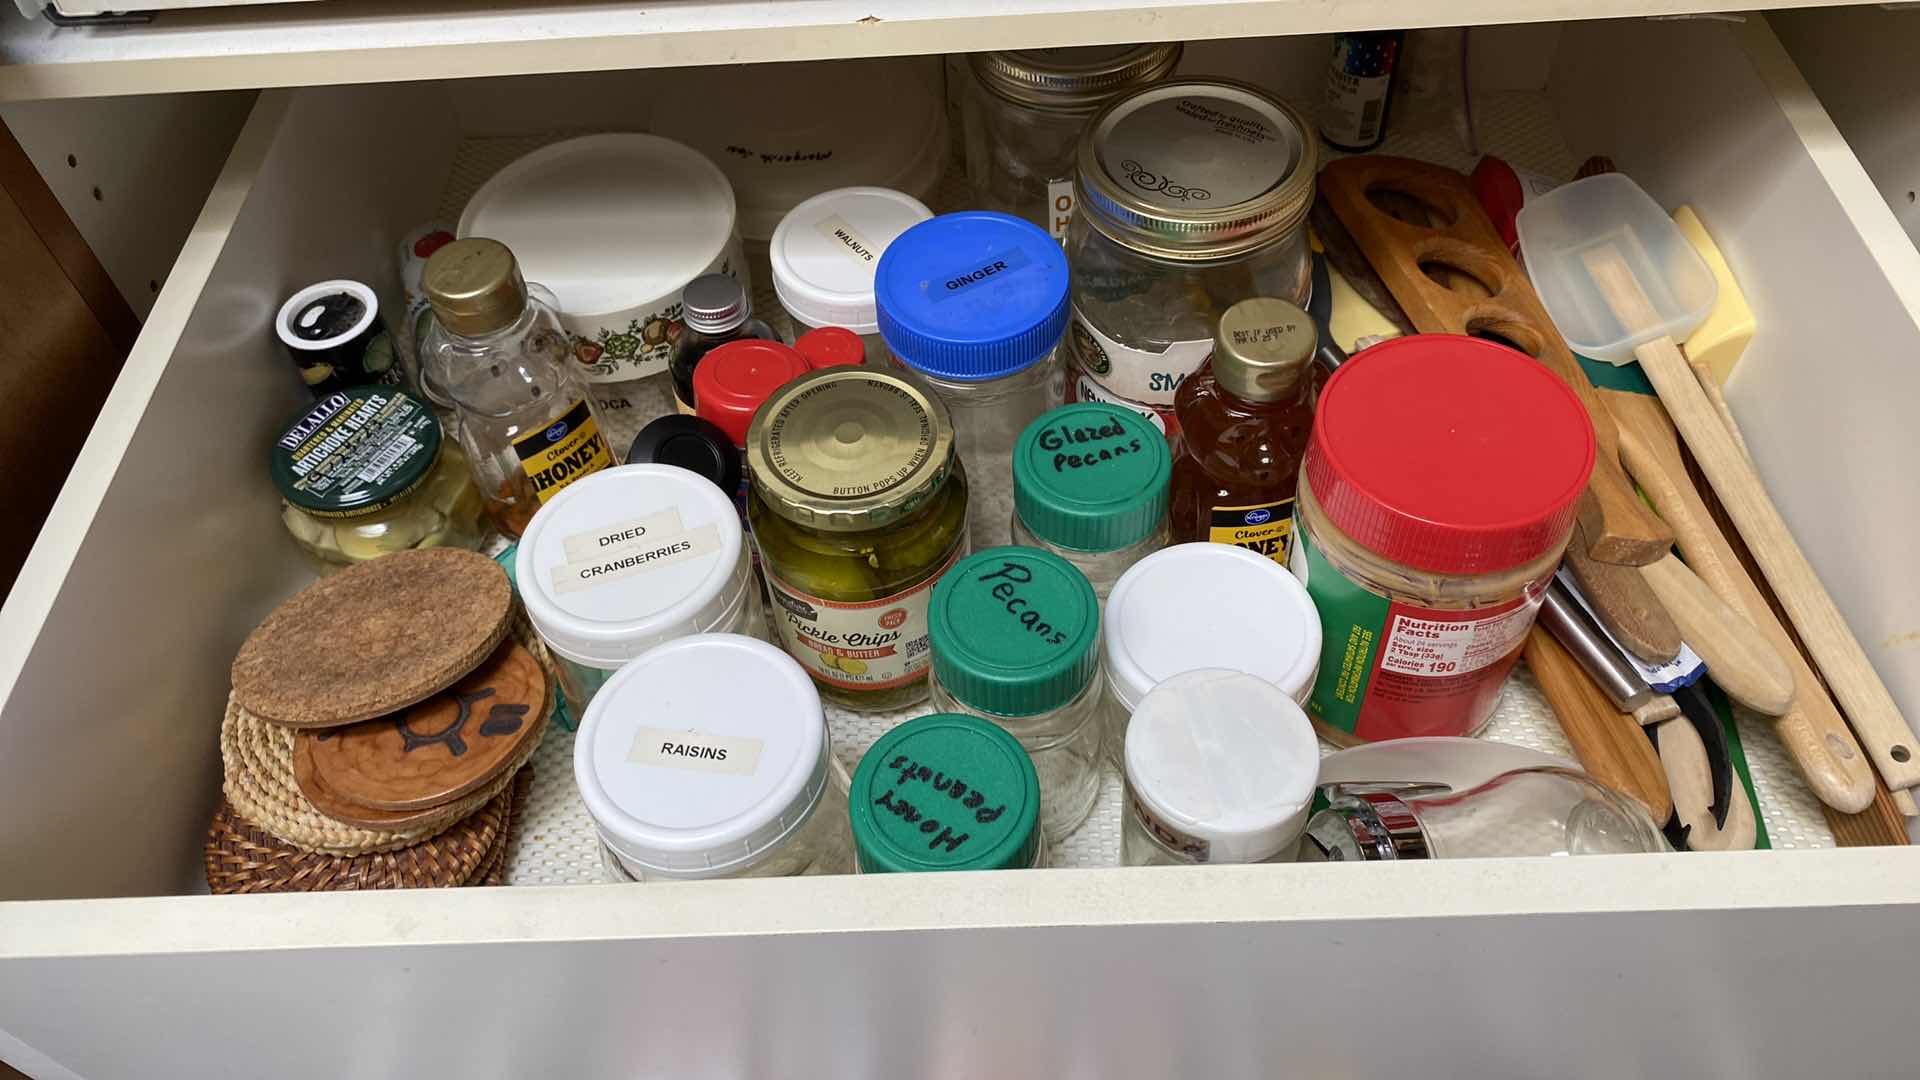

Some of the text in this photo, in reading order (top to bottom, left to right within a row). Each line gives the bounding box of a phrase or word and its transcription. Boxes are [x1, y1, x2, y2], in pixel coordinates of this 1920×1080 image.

[833, 227, 875, 262] WALNUTS
[945, 260, 1009, 291] GINGER
[282, 394, 346, 450] DELALLO
[1039, 415, 1127, 451] Glazed
[291, 423, 354, 478] ARTICHOKE
[347, 393, 389, 434] HEARTS
[535, 433, 601, 491] HONEY
[546, 438, 579, 462] Clover
[784, 467, 804, 484] KEEP
[833, 484, 870, 496] BUTTON
[874, 475, 897, 491] POPS
[897, 467, 909, 480] UP
[907, 448, 928, 473] WHEN
[598, 525, 647, 547] DRIED
[1234, 527, 1274, 540] Clover
[1234, 533, 1289, 557] NEY
[579, 540, 692, 580] CRANBERRIES
[978, 561, 1067, 645] Pecans
[785, 611, 902, 648] Pickle Chips
[1397, 626, 1441, 640] Facts
[1399, 617, 1470, 633] Nutrition
[847, 649, 881, 658] BUTTER
[1391, 640, 1435, 654] Serv. size
[1398, 648, 1420, 659] Tbsp
[1387, 655, 1457, 673] Calories 190
[660, 742, 728, 761] RAISINS
[888, 755, 1008, 824] Peanuts
